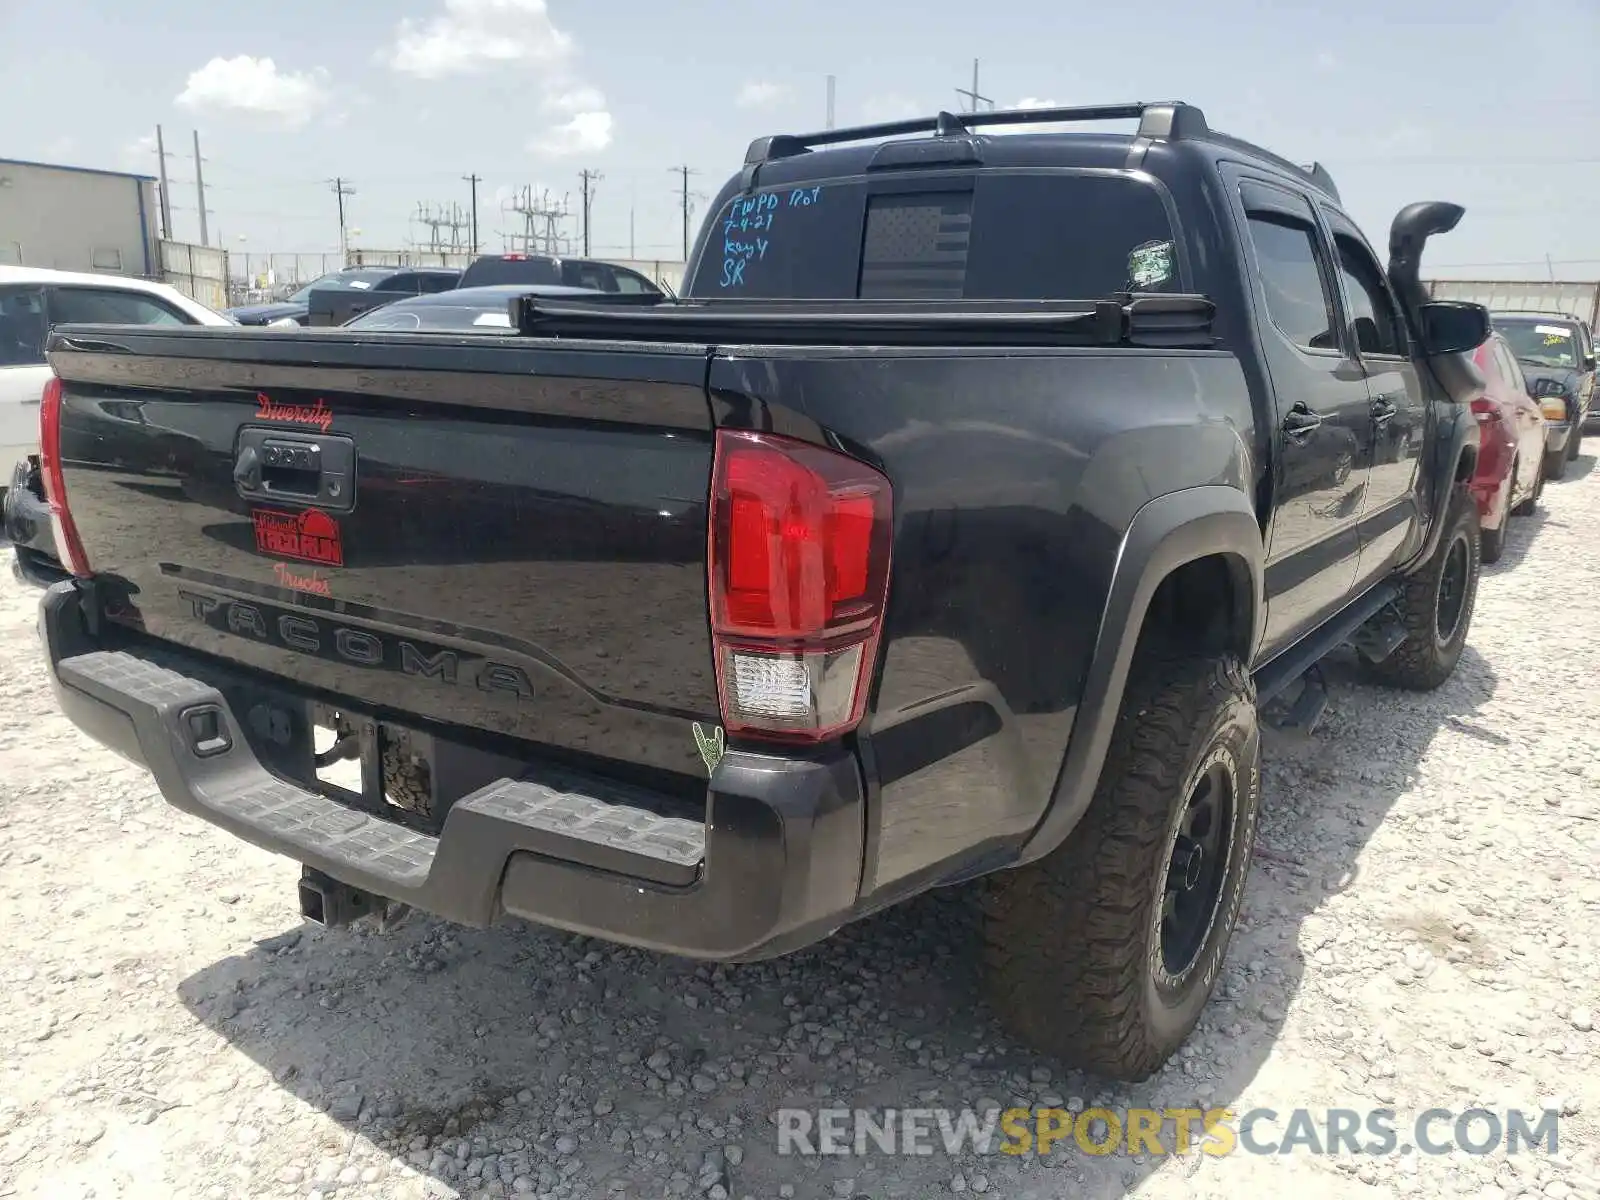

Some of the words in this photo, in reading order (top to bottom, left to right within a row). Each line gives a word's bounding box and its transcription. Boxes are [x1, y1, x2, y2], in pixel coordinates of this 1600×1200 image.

[731, 193, 778, 218] FWPD
[720, 258, 746, 287] SR
[255, 392, 333, 433] Divercity
[256, 527, 300, 554] TACO
[300, 534, 341, 563] RUN
[273, 563, 333, 599] Trucks
[178, 585, 536, 700] TACOMA
